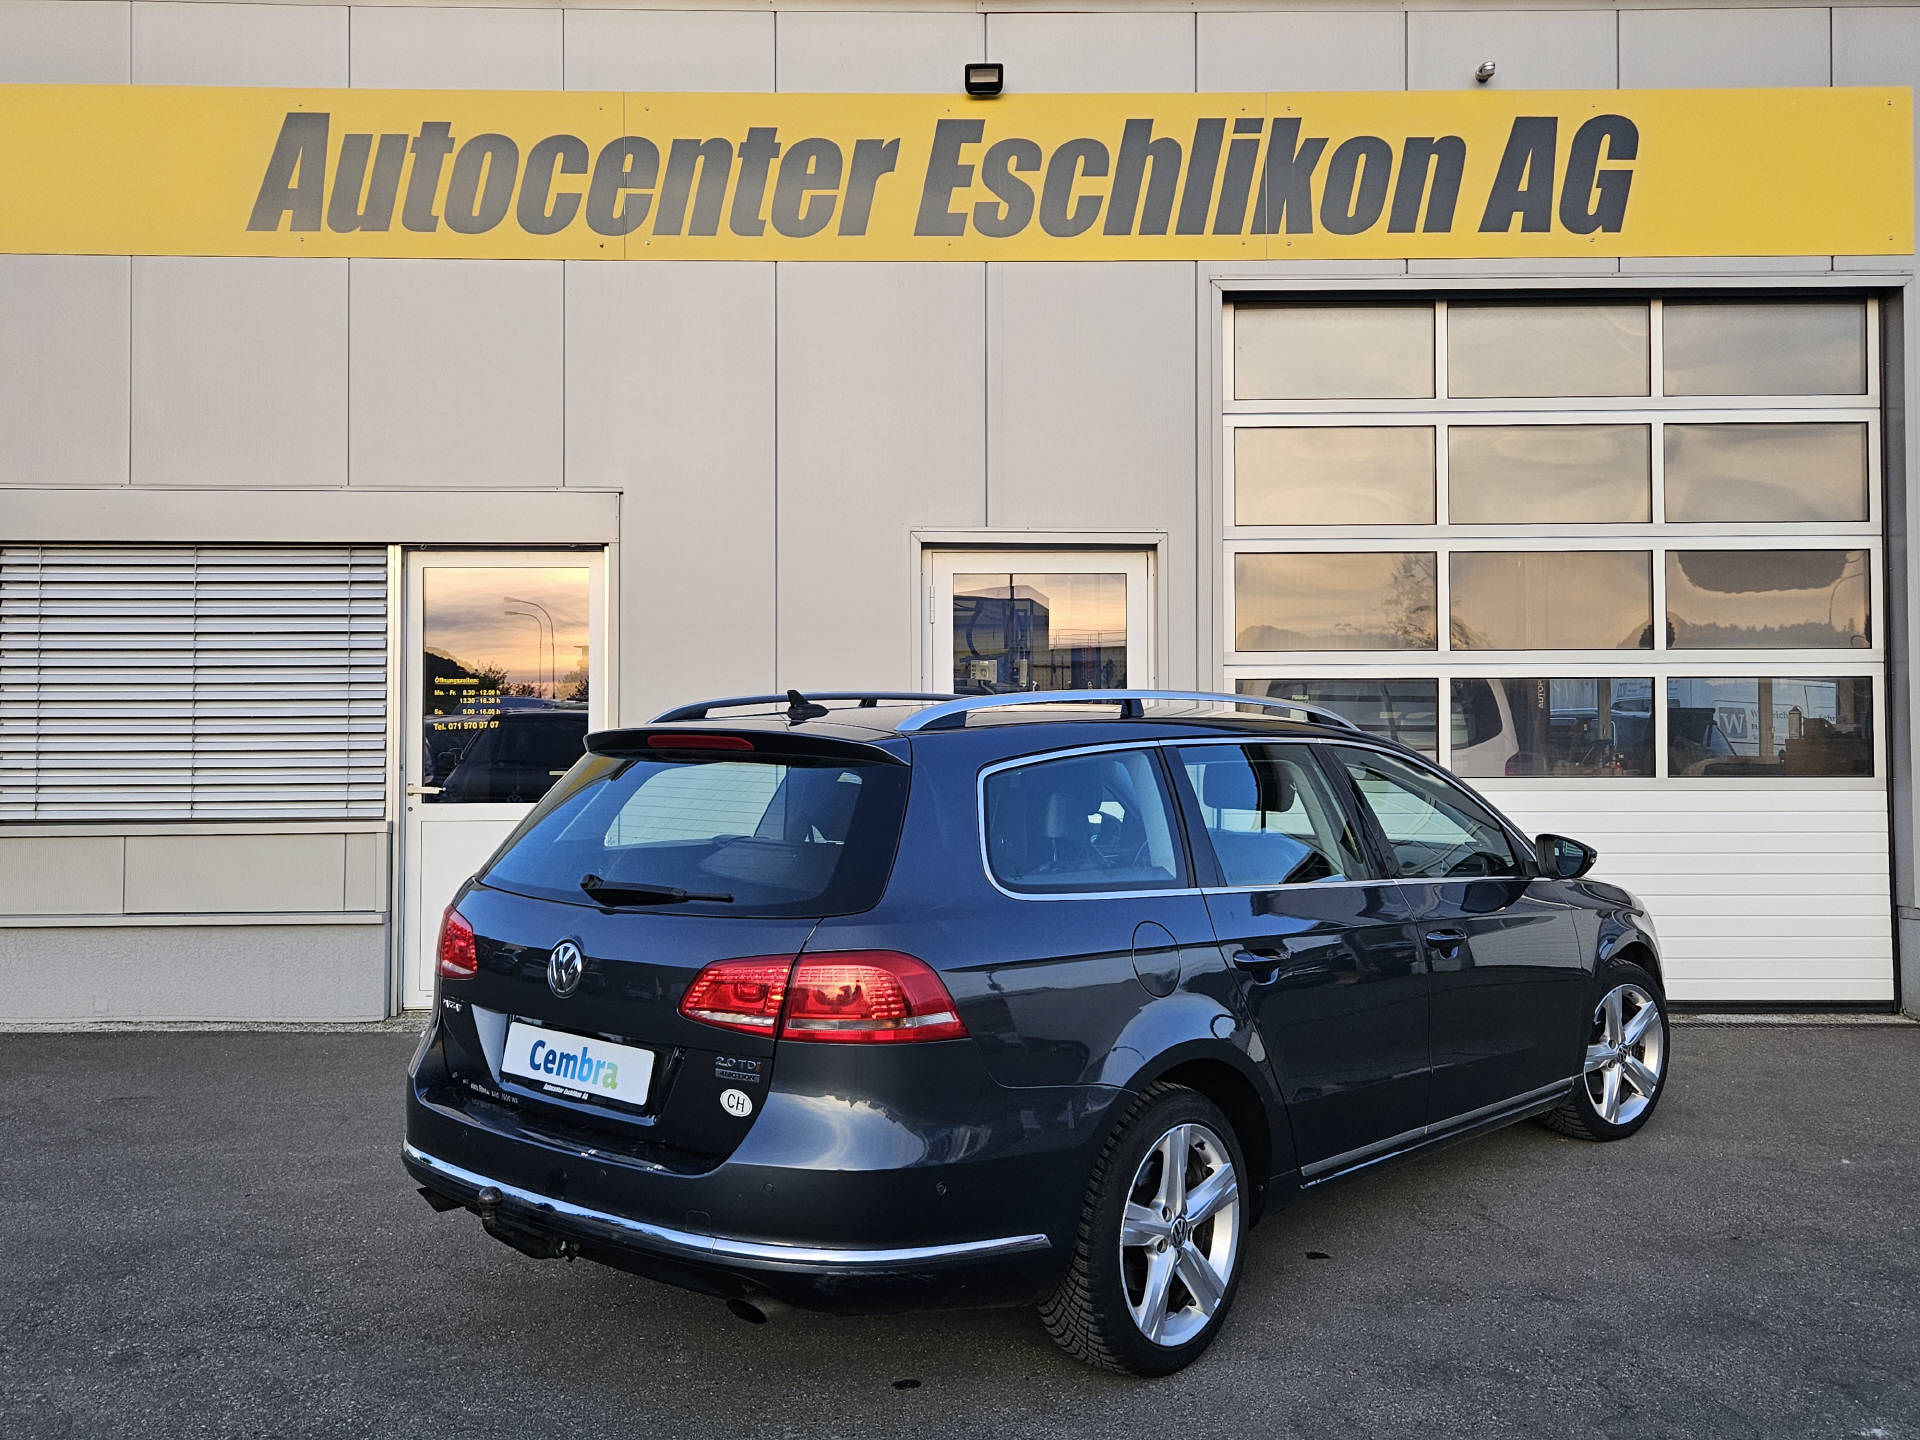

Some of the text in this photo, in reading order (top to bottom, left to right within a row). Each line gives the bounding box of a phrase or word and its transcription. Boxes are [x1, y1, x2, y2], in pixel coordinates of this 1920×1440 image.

[246, 112, 1640, 238] Autocenter Eschlikon AG
[433, 720, 499, 731] Tel. 071 970 07 07
[1720, 711, 1745, 735] W
[529, 1039, 618, 1090] Cembra
[727, 1093, 745, 1112] CH
